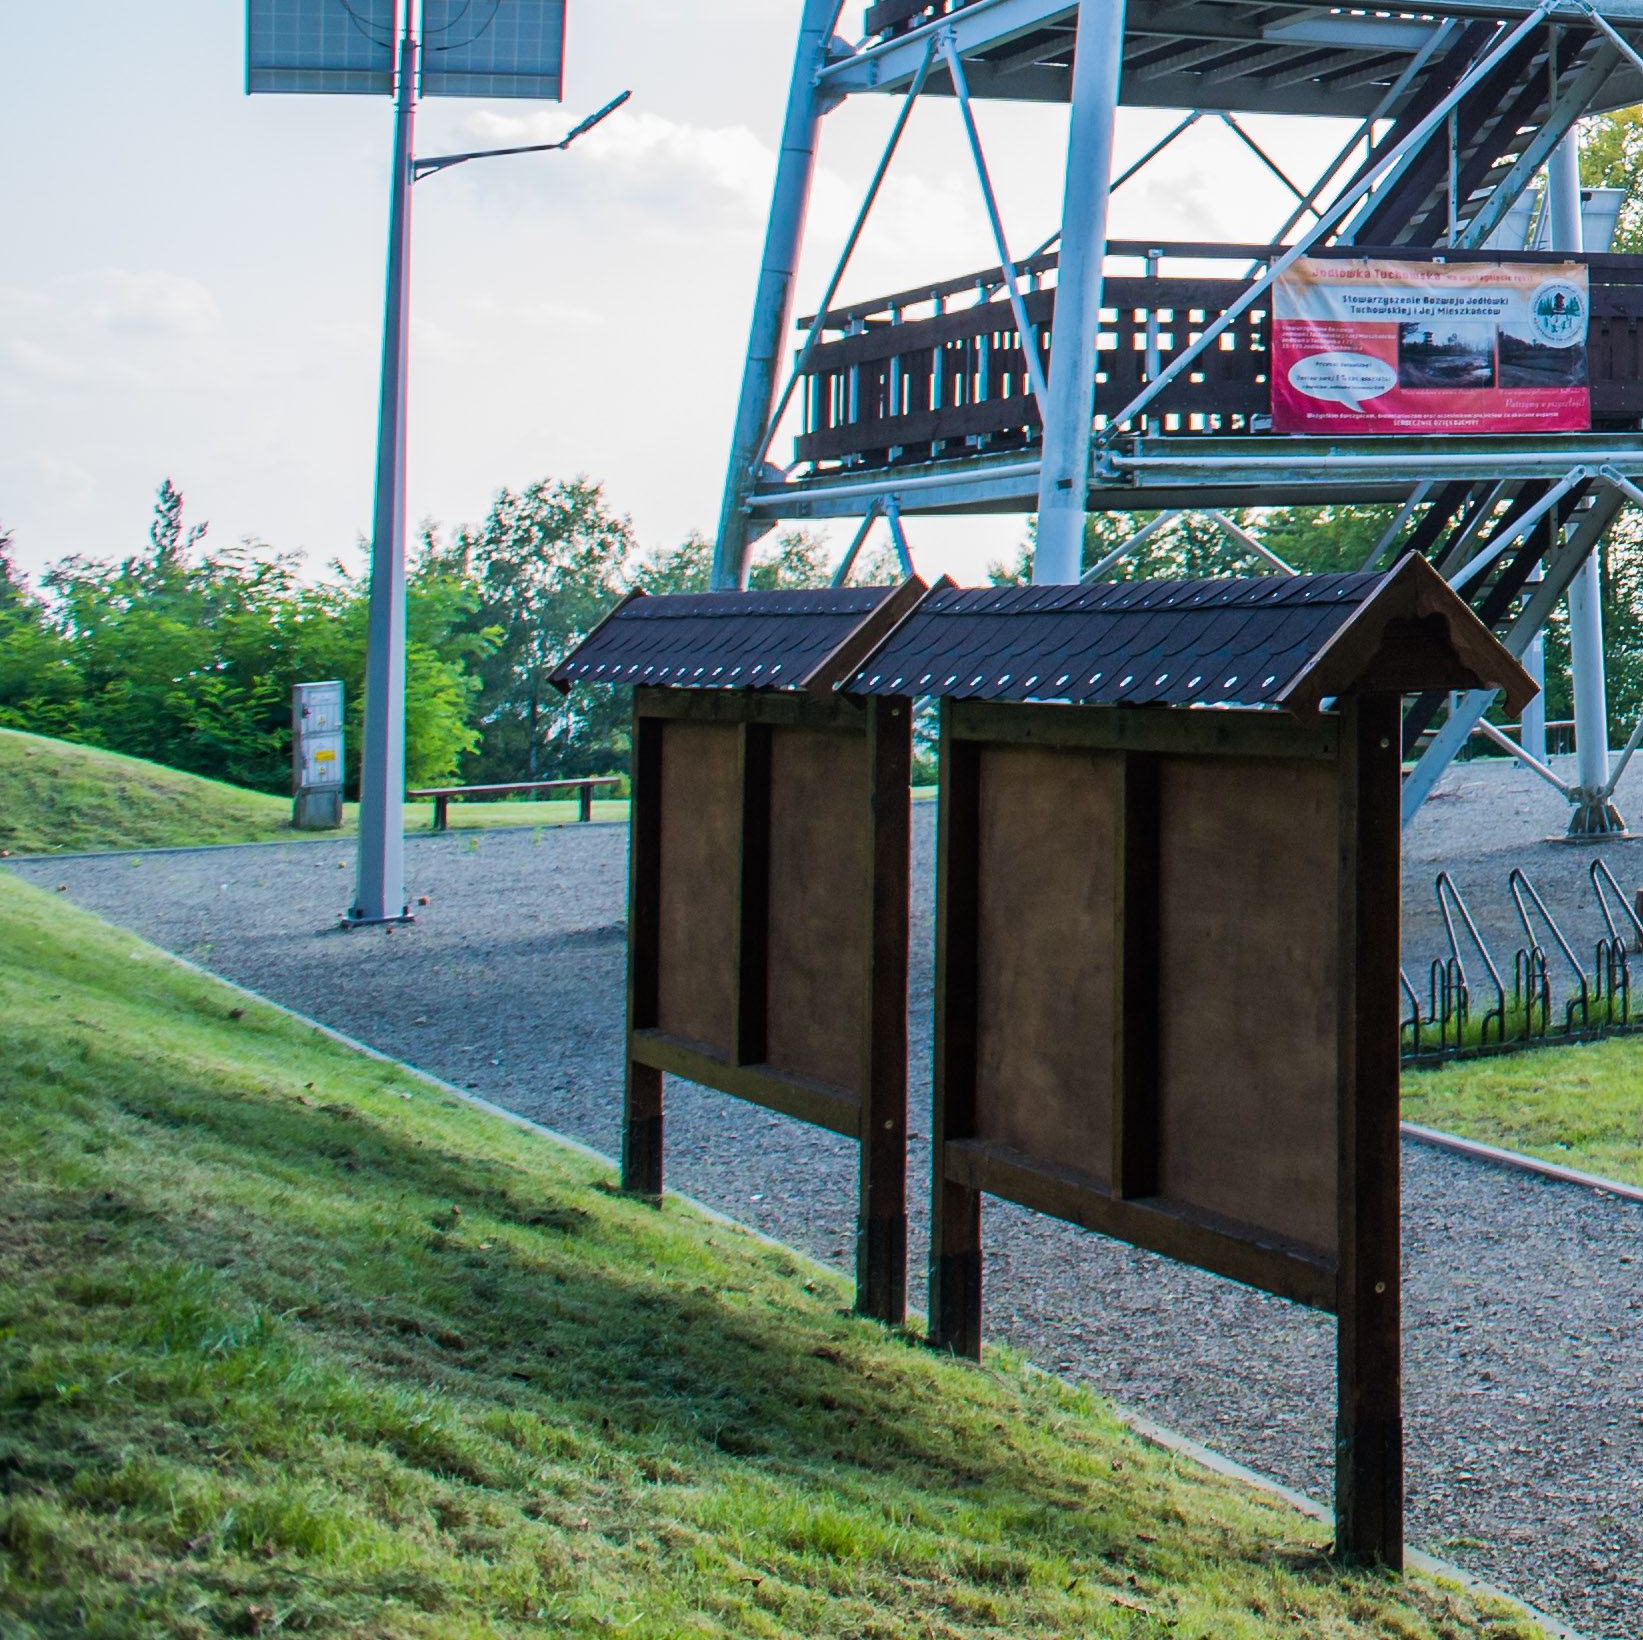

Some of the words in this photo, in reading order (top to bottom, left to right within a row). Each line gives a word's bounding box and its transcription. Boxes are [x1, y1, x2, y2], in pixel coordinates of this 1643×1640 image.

[1343, 295, 1420, 305] Stowarzyszenie
[1424, 296, 1464, 306] Rozwoju
[1350, 305, 1411, 315] Tuchowskiej
[1419, 307, 1435, 316] Jej
